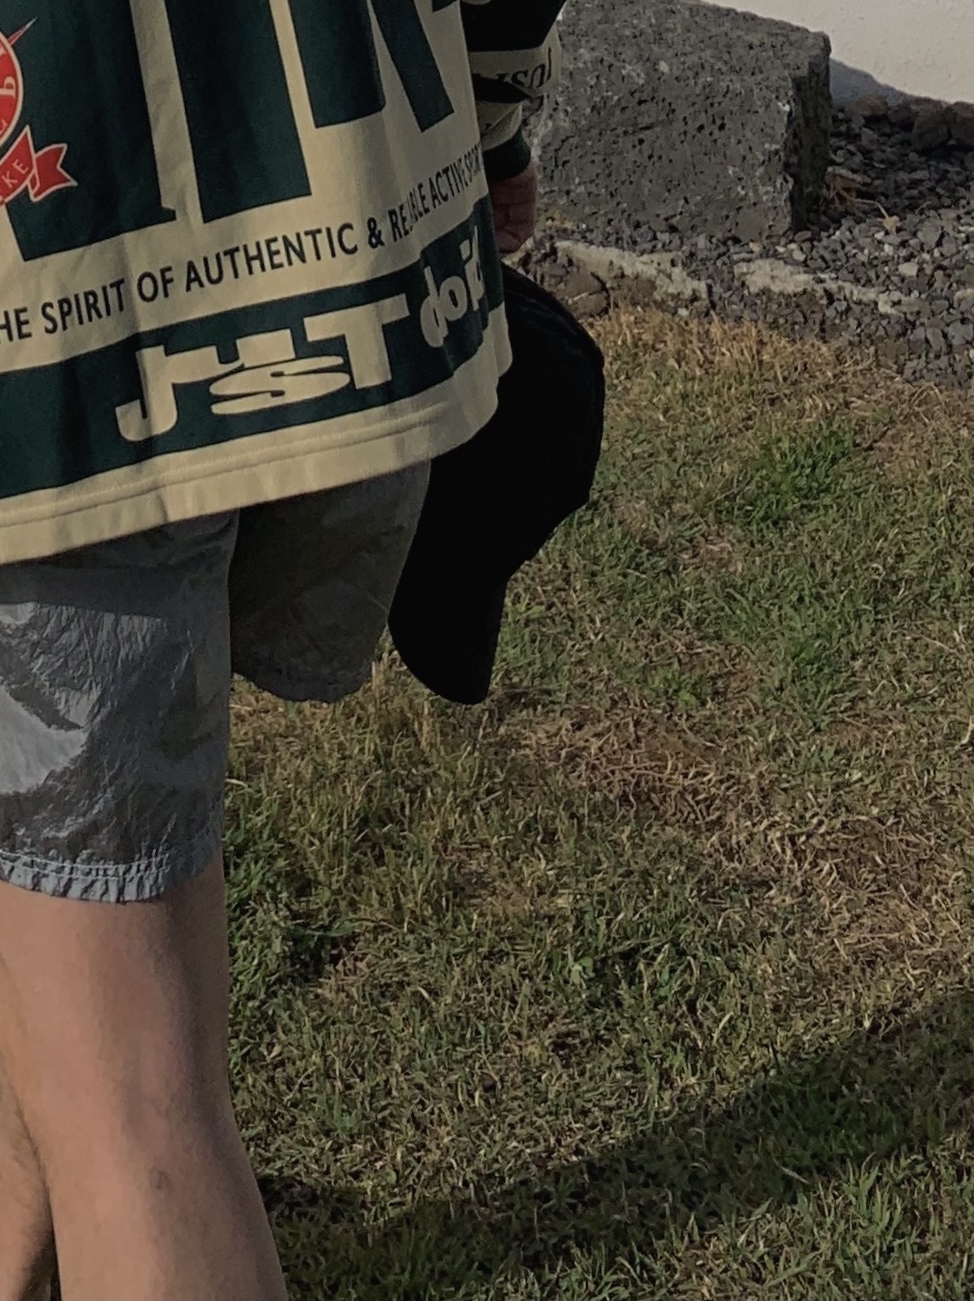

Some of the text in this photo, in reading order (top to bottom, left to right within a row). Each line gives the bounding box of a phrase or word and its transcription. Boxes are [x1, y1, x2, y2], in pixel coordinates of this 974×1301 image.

[42, 279, 126, 333] SPIRIT
[137, 265, 176, 303] OF
[185, 222, 359, 292] AUTHENTIC
[366, 217, 385, 249] &
